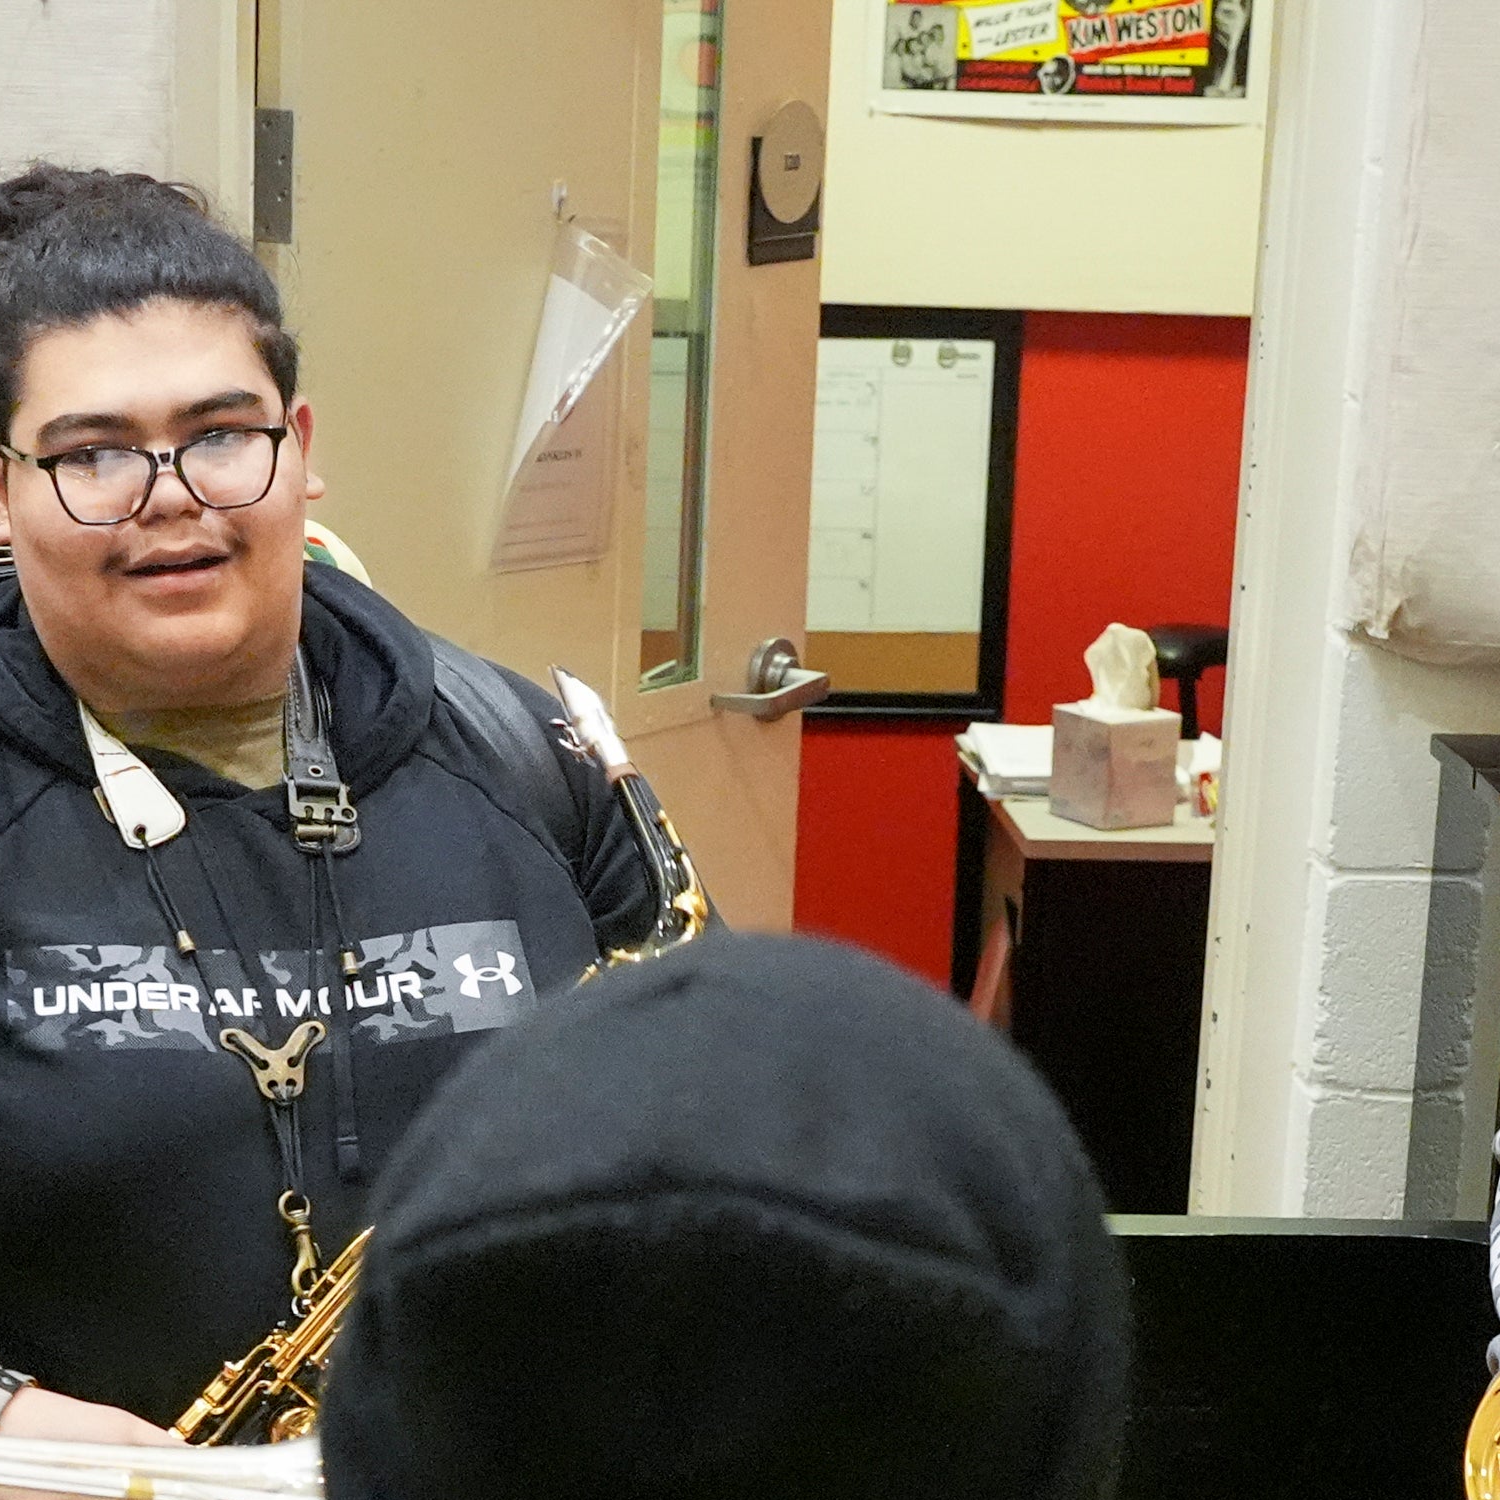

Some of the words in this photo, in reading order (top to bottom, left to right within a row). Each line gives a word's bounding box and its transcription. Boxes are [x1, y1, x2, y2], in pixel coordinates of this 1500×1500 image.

[1070, 19, 1110, 49] KIM
[1115, 4, 1201, 41] WESTON
[33, 981, 202, 1016] UNDER
